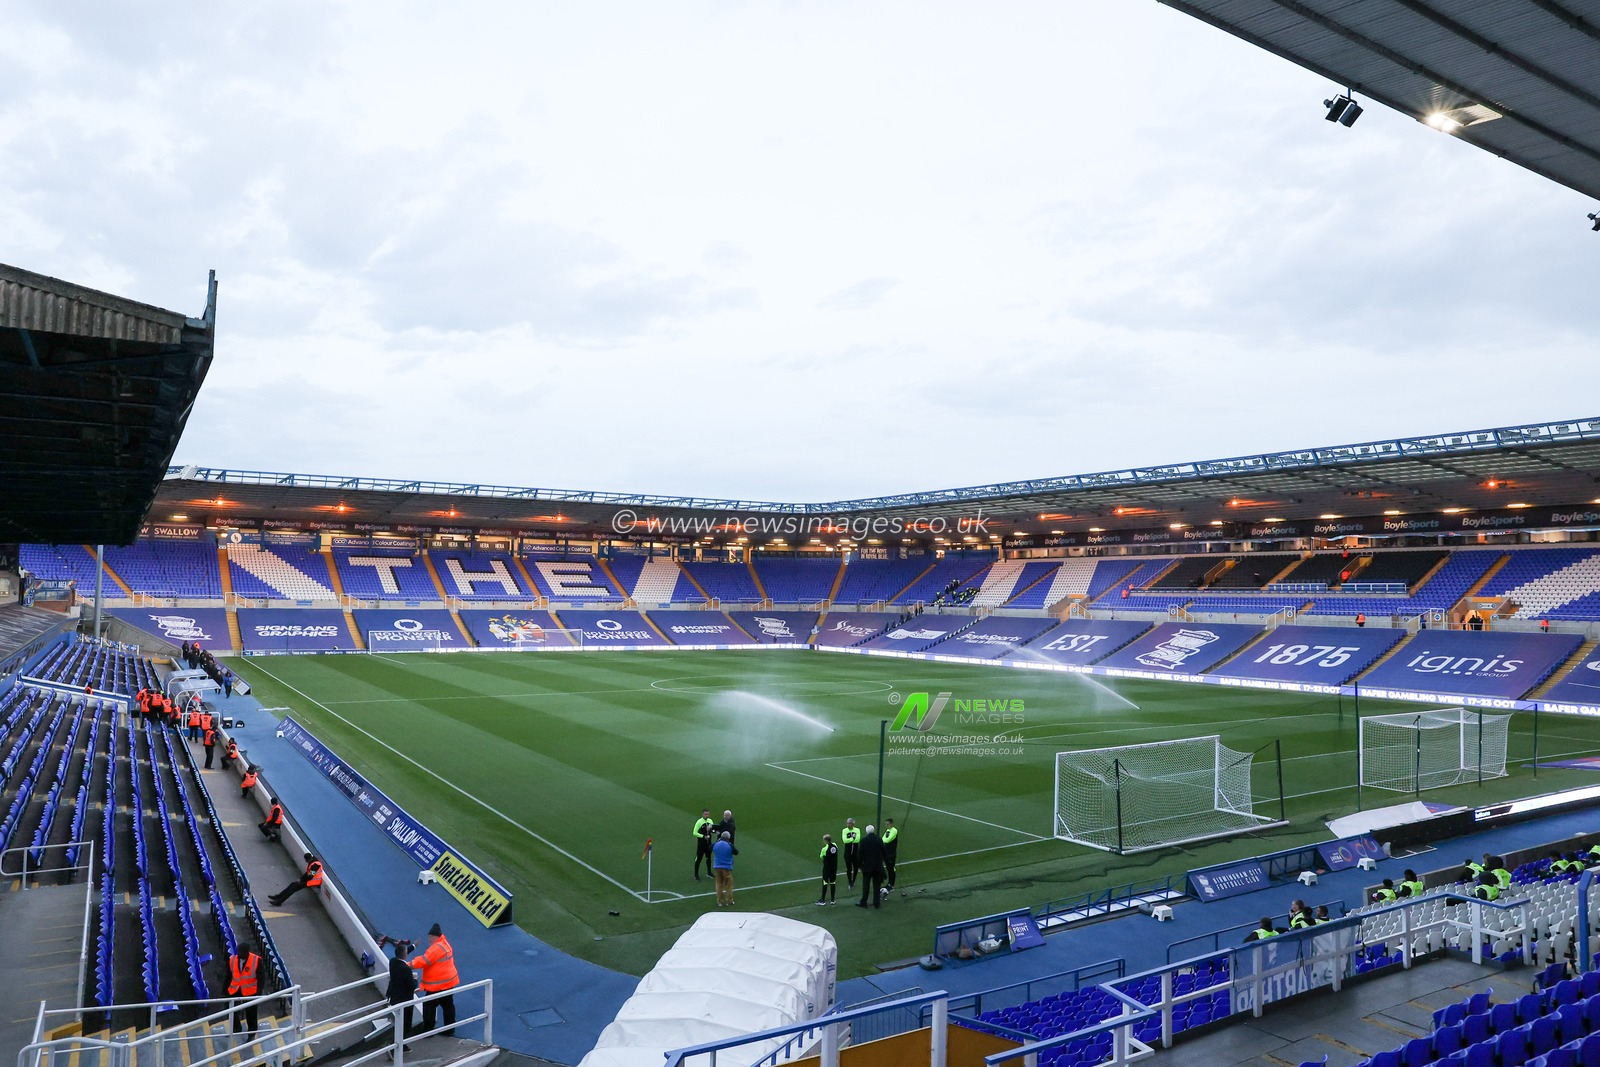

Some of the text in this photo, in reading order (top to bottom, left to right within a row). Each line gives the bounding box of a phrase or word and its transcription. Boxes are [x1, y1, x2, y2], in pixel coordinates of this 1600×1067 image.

[216, 517, 256, 526] BoyleSports
[264, 519, 302, 527] BoyleSports
[1384, 519, 1439, 531] BoyleSports
[1462, 515, 1525, 528] BoyleSports
[154, 527, 199, 536] SWALLOW
[1251, 526, 1296, 537] BoyleSports
[1314, 523, 1363, 534] BoyleSports
[1006, 539, 1033, 547] BoyleSports
[1044, 537, 1076, 546] BoyleSports
[1087, 535, 1120, 544] BoyleSports
[1134, 533, 1169, 542] BoyleSports
[393, 540, 416, 548] Coatings
[1041, 634, 1109, 653] EST.
[1253, 643, 1360, 668] 1875
[1407, 651, 1524, 673] ignis
[1242, 679, 1279, 690] GAMBLING
[1280, 682, 1301, 691] WEEK
[1303, 684, 1323, 693] 17-23
[1323, 686, 1340, 694] OCT
[1361, 689, 1516, 709] SAFER GAMBLING WEEK 17-23 OCT
[1543, 703, 1579, 714] SAFER
[386, 816, 422, 848] SWALLOW
[1213, 868, 1262, 884] BIRMINGHAM CITY
[434, 855, 502, 919] SnatchPac Ltd
[1216, 875, 1260, 890] FOOTBALL CLUB
